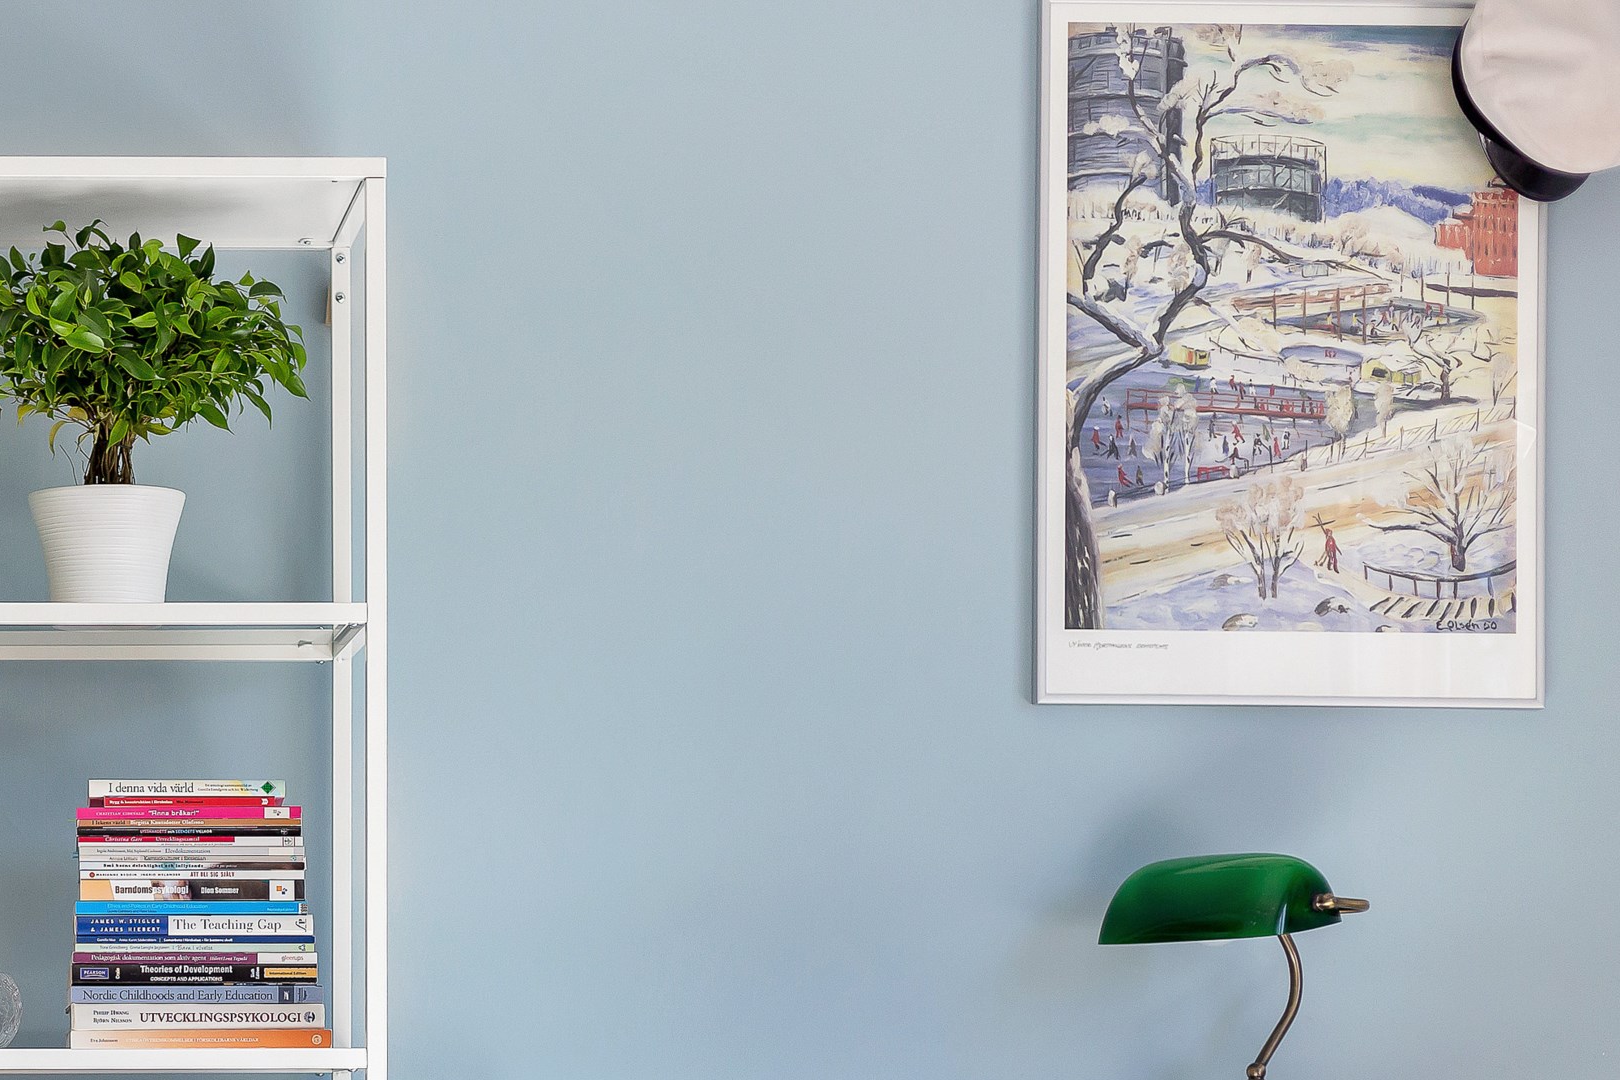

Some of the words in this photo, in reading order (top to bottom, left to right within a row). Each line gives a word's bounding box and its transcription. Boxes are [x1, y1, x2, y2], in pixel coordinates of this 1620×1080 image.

[108, 783, 112, 793] I
[115, 782, 145, 793] denna
[147, 782, 168, 793] vida
[170, 782, 194, 793] värld
[115, 884, 189, 896] Barndomspsykologi
[200, 886, 213, 894] Dion
[214, 886, 239, 894] Sommer
[173, 919, 197, 930] The
[200, 919, 253, 933] Teaching
[257, 919, 282, 933] Gap
[140, 965, 173, 974] Theories
[174, 965, 184, 973] of
[185, 965, 233, 975] Development
[83, 989, 117, 1001] Nordic
[120, 989, 174, 1001] Childhoods
[177, 990, 195, 1001] and
[198, 989, 223, 1003] Early
[225, 989, 273, 1001] Education
[140, 1012, 301, 1023] UTVECKLINGSPSYKOLOGI
